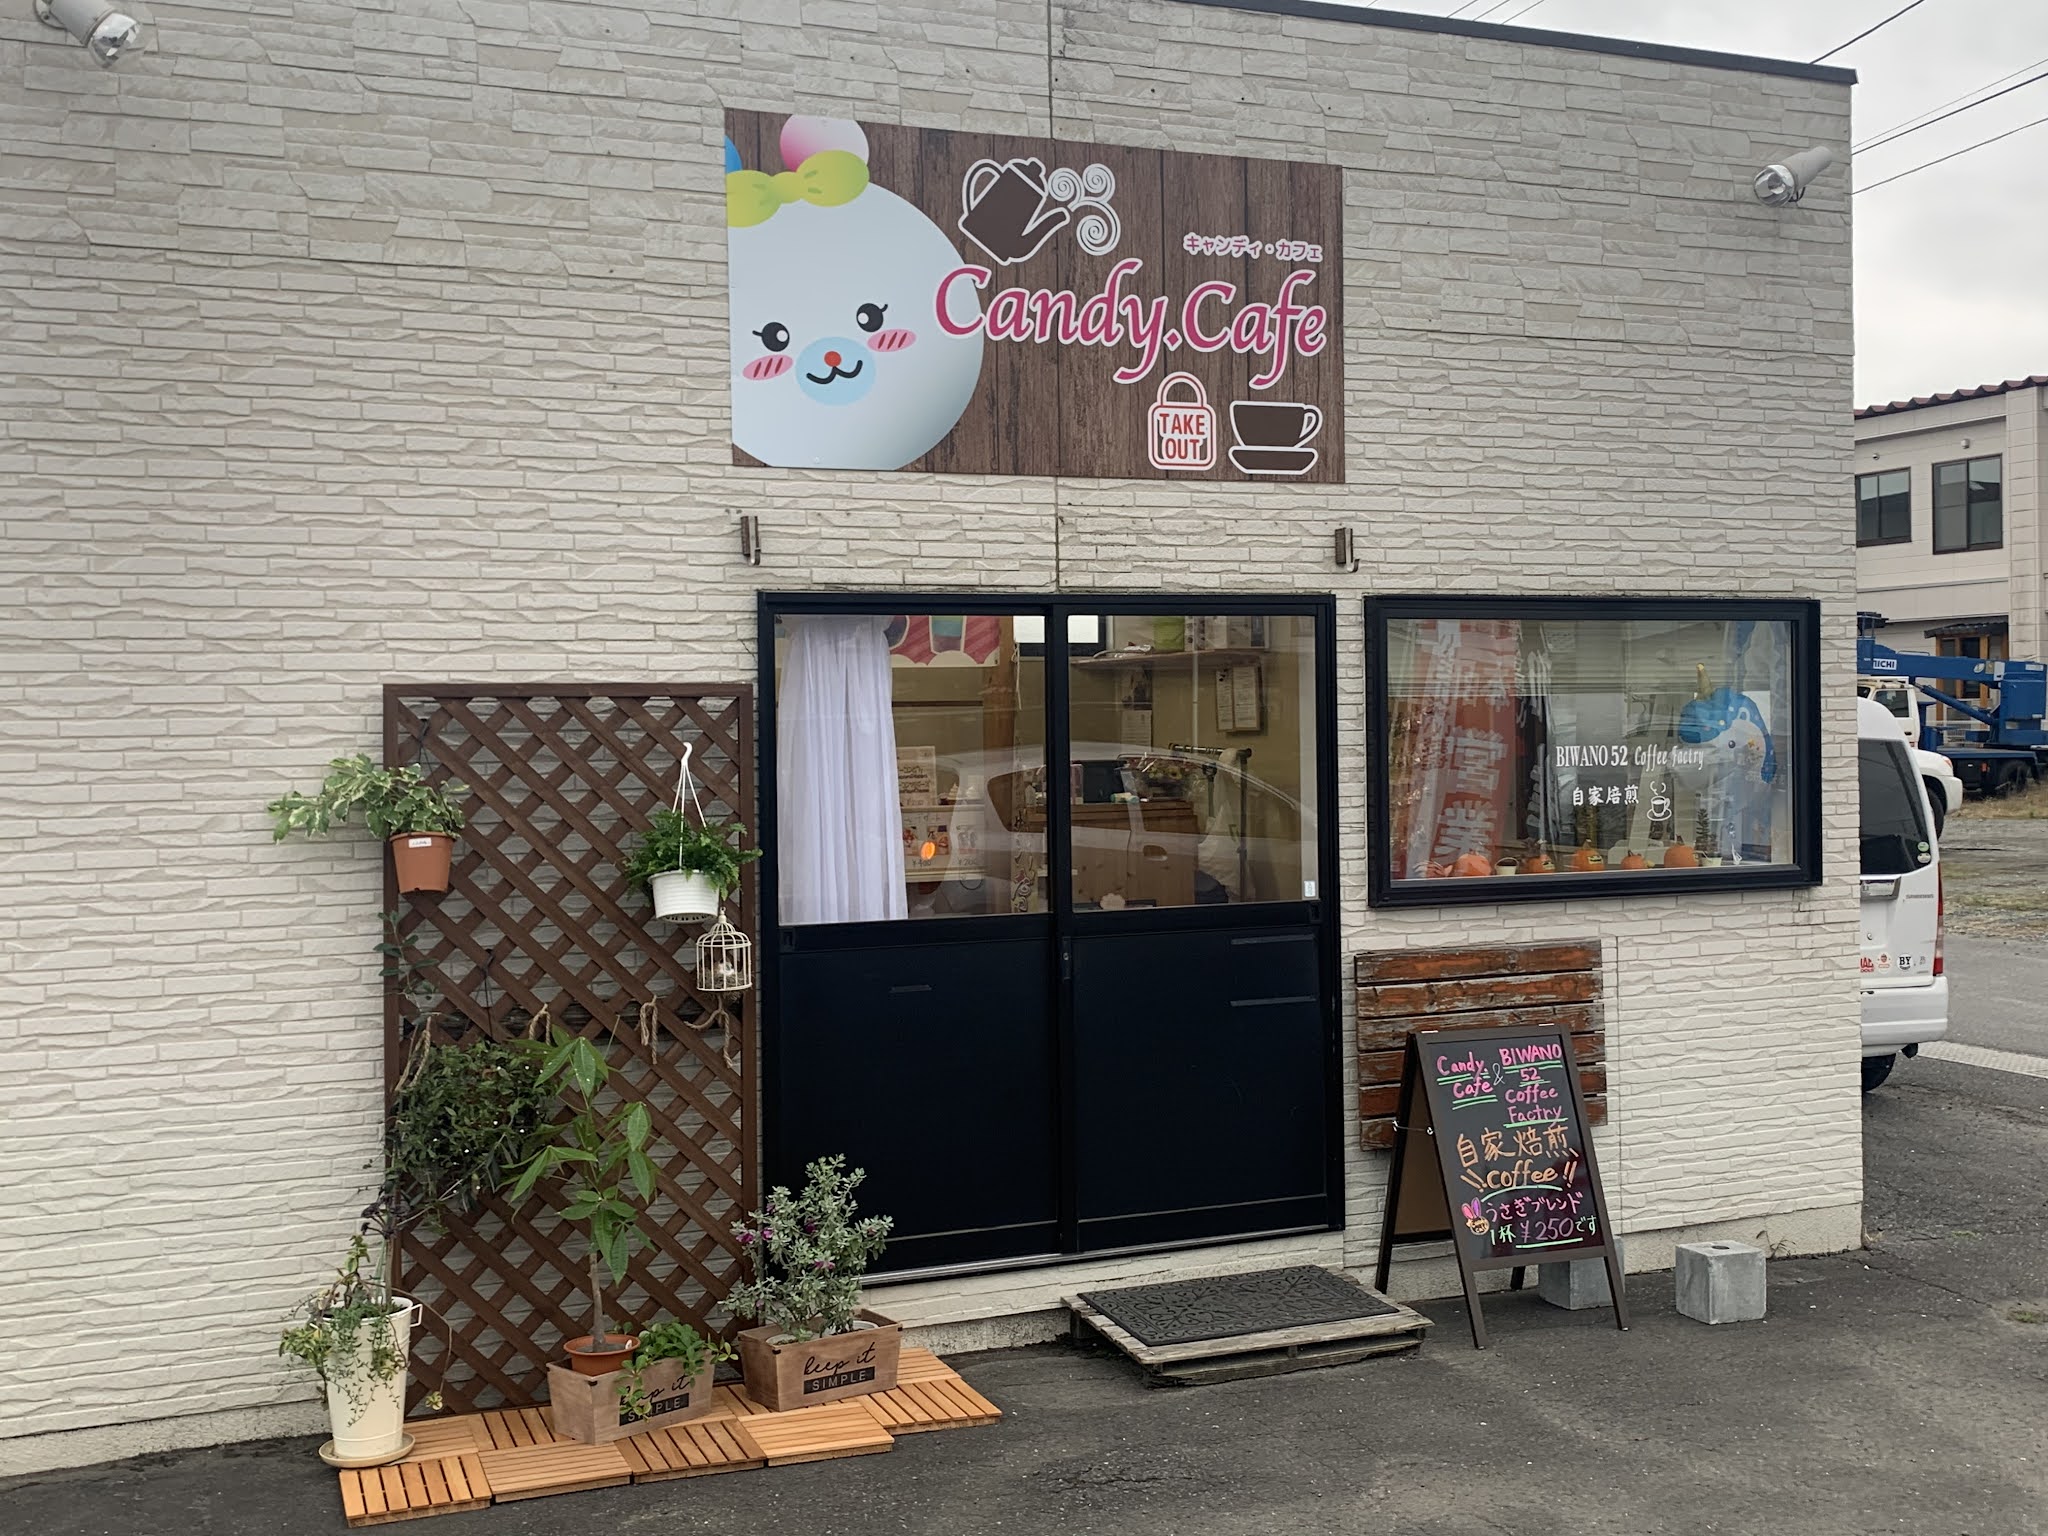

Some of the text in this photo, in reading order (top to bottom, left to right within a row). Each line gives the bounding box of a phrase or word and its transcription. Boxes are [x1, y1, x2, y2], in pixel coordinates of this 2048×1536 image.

[1184, 232, 1323, 262] キャンディ・カフェ
[1159, 413, 1205, 435] TAKE
[1165, 438, 1200, 459] OUT
[1556, 745, 1608, 767] BIWANO
[1610, 745, 1628, 766] 52
[1634, 744, 1667, 772] Coffee
[1572, 784, 1639, 806] 自家焙煎
[1899, 956, 1911, 965] BY
[1499, 1044, 1562, 1066] BIWANO
[1492, 1063, 1505, 1085] &
[1520, 1067, 1541, 1081] 52
[1453, 1077, 1493, 1098] Cafe
[1505, 1083, 1558, 1104] Coffee
[1508, 1105, 1562, 1127] Factry
[1457, 1125, 1579, 1168] 自家焙煎
[1486, 1192, 1583, 1222] うさぎブレンド
[804, 1342, 876, 1375] keep it
[812, 1370, 866, 1391] SIMPLE
